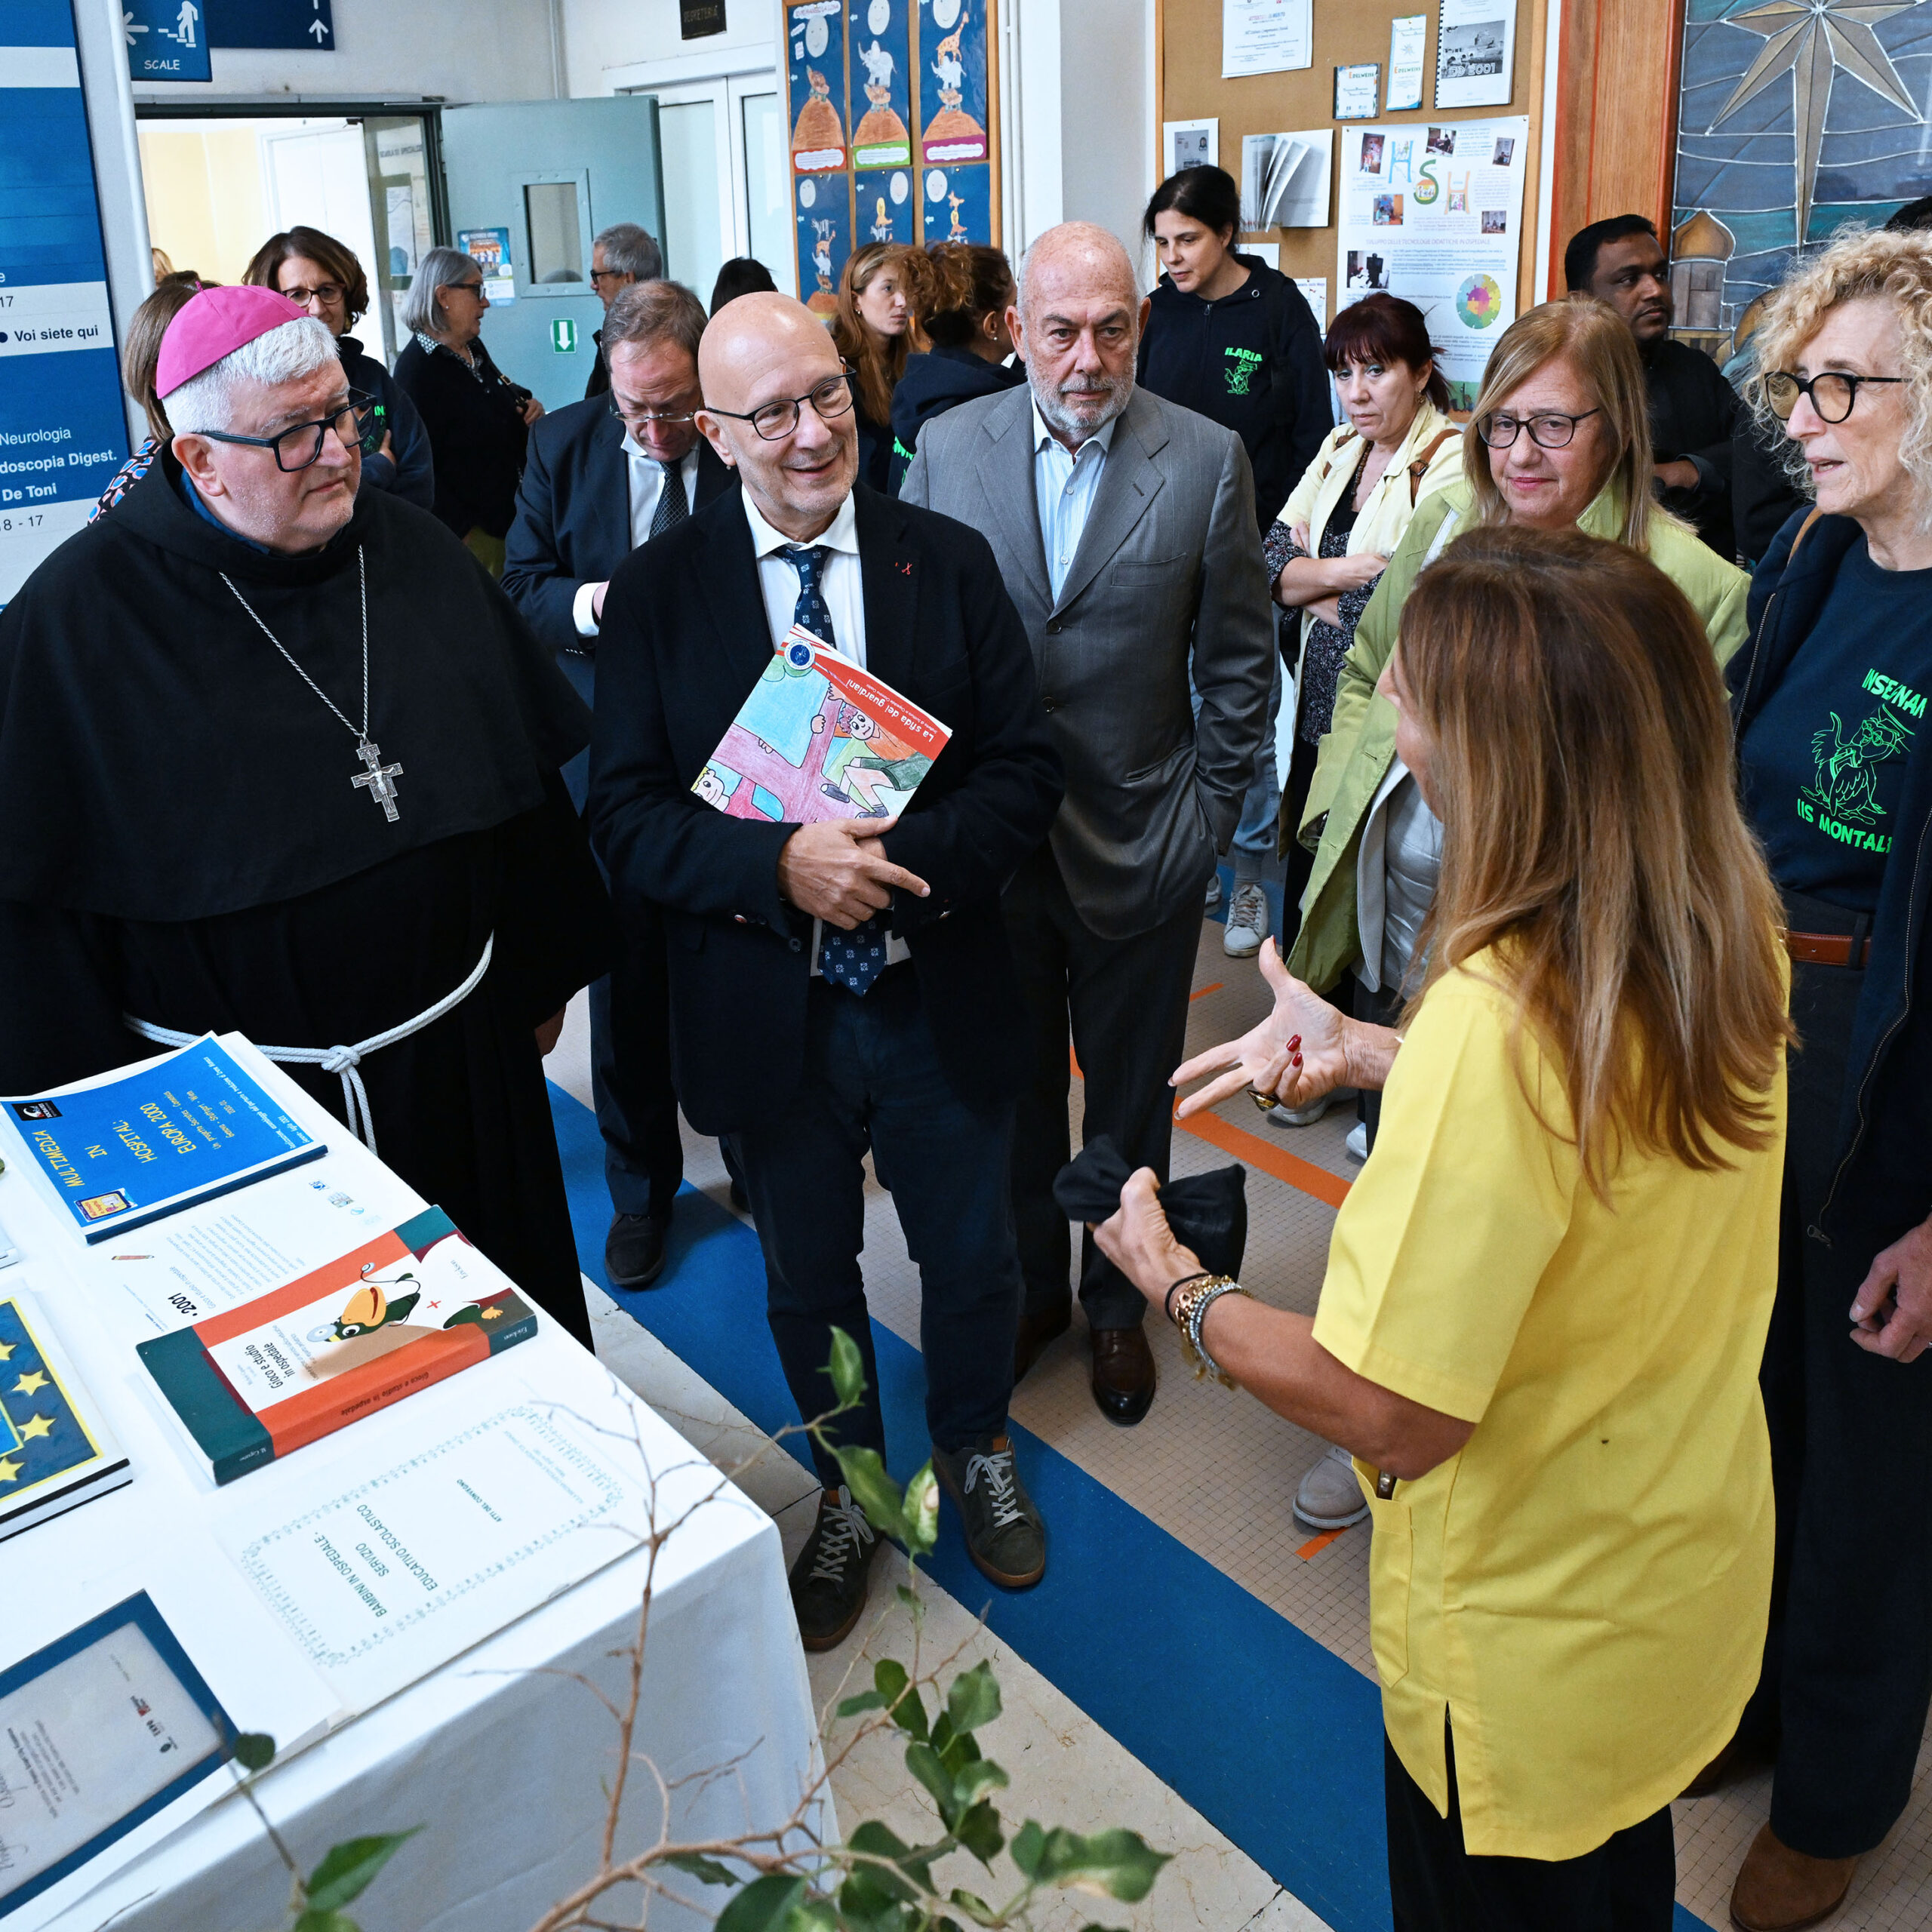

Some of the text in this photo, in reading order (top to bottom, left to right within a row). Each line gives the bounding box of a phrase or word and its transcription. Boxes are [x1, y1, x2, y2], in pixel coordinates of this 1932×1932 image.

[144, 60, 180, 70] SCALE
[1469, 63, 1495, 75] 2001
[14, 325, 98, 341] Voi siete qui
[1225, 348, 1263, 362] ILARIA
[0, 428, 72, 445] Neurologia
[69, 450, 117, 466] Digest.
[2, 483, 57, 501] De Toni
[29, 515, 43, 527] 17
[847, 677, 934, 741] La sfida dei guardiani
[1798, 798, 1814, 823] IIS
[38, 1103, 51, 1117] SOCRATES
[179, 1110, 198, 1126] Socrates
[198, 1103, 220, 1121] Stuttgart
[139, 1102, 195, 1153] EUROPA 2000
[194, 1124, 216, 1141] progetto
[217, 1124, 234, 1137] Genova
[111, 1119, 155, 1162] HOSPITAL:
[33, 1129, 84, 1188] MULTIMEDIA
[85, 1143, 107, 1158] IN
[168, 1293, 196, 1314] 2001
[504, 1325, 526, 1341] Erickson
[242, 1344, 265, 1365] studio
[260, 1341, 294, 1378] in ospedale
[262, 1369, 283, 1388] Gioco
[411, 1371, 428, 1385] Gioco
[372, 1393, 379, 1402] in
[382, 1383, 401, 1398] studio
[341, 1396, 370, 1417] ospedale
[455, 1478, 502, 1522] ATTI DEL CONVEGNO
[313, 1536, 352, 1574] OSPEDALE
[355, 1505, 438, 1589] EDUCATIVO SCOLASTICO
[355, 1542, 389, 1576] SERVIZIO
[346, 1574, 359, 1584] IN
[353, 1583, 387, 1616] BAMBINI
